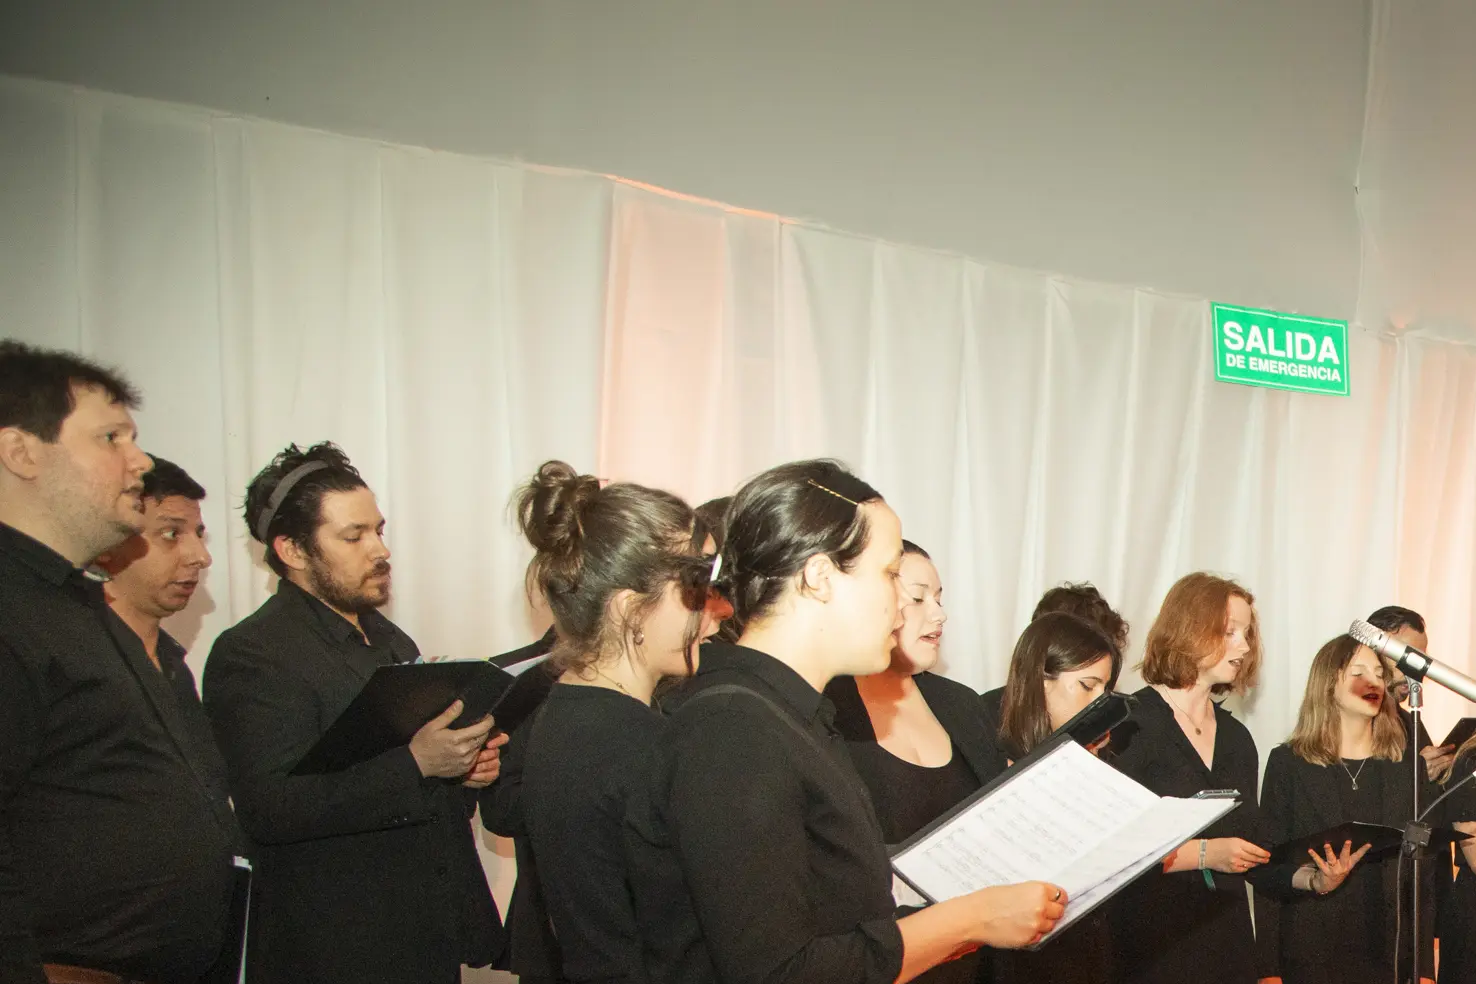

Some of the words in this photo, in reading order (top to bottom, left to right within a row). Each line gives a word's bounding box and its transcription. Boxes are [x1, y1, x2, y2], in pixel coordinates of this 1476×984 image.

[1223, 321, 1340, 364] SALIDA
[1226, 353, 1246, 369] DE
[1249, 356, 1341, 382] EMERGENCIA
